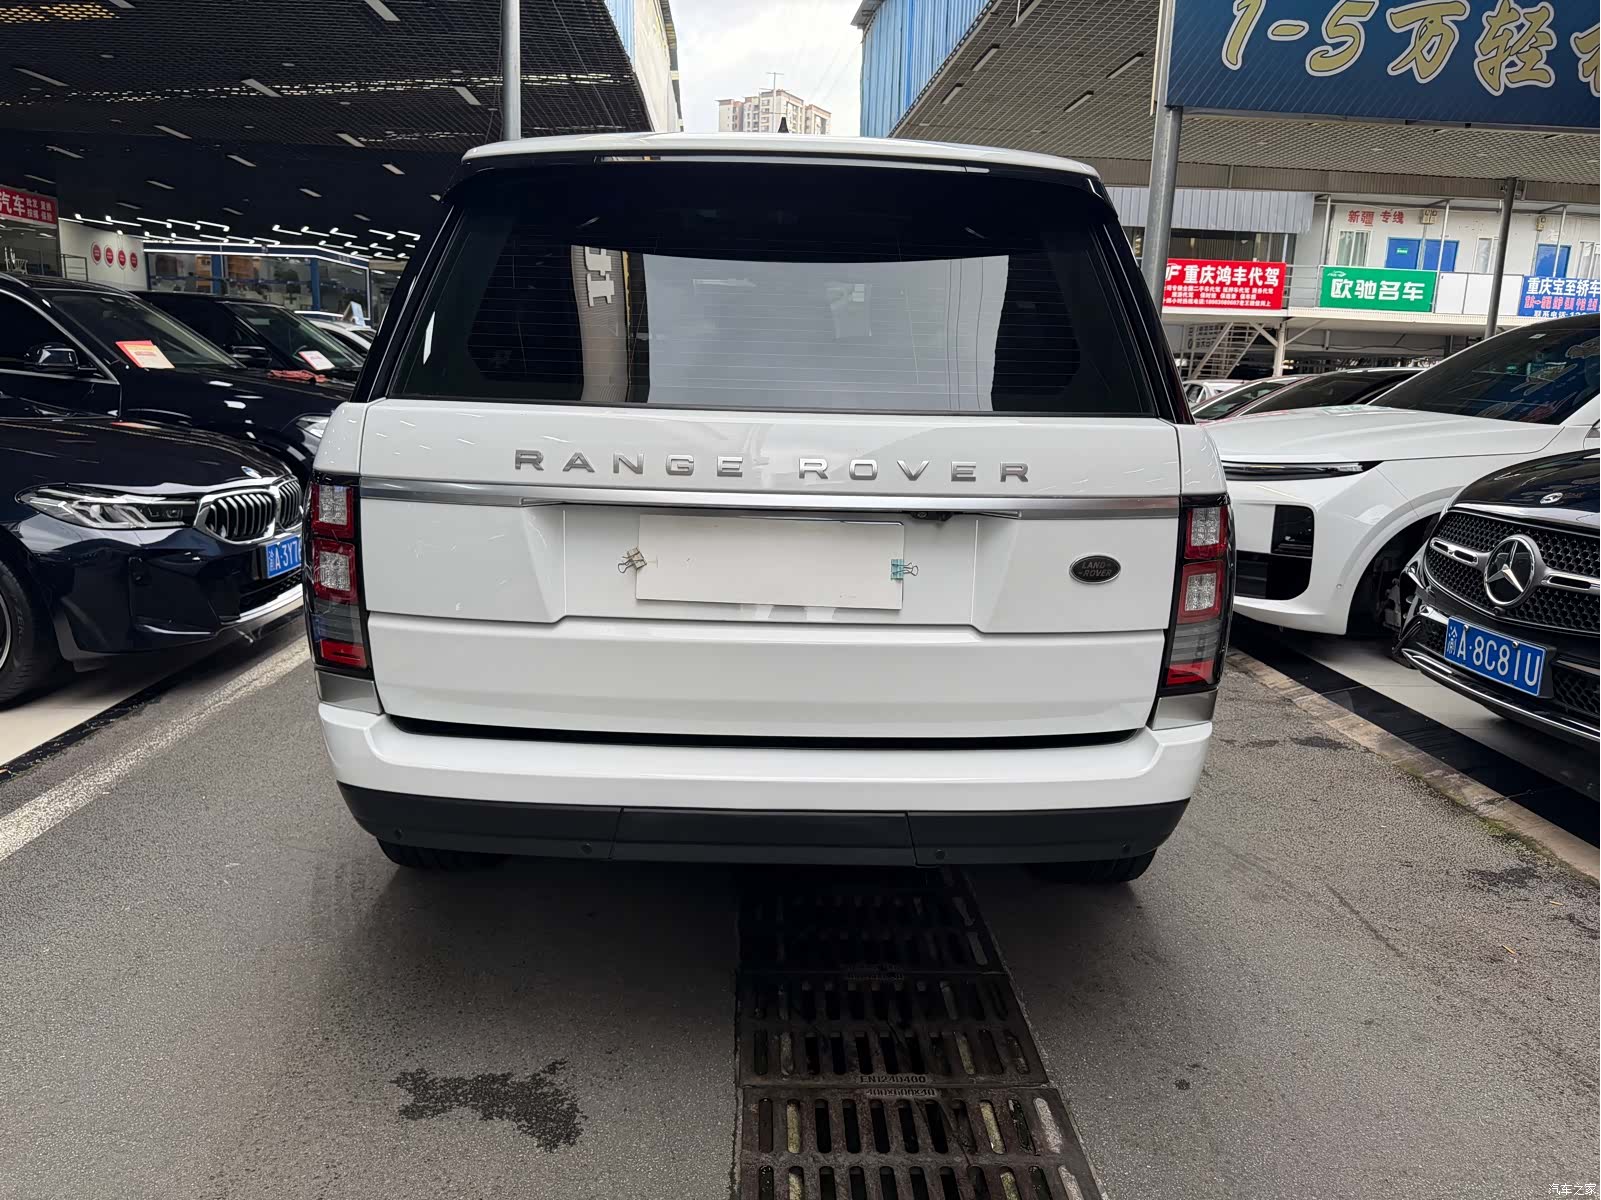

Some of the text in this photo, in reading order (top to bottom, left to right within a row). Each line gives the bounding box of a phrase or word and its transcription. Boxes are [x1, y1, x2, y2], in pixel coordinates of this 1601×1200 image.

[0, 191, 26, 217] 汽车
[1348, 210, 1404, 226] 新疆 专线
[1183, 264, 1280, 287] 重庆鸿丰代驾
[1330, 278, 1425, 301] 欧驰名车
[1526, 277, 1600, 297] 重庆宝至轿车
[515, 449, 1029, 483] RANGE ROVER
[1081, 561, 1106, 569] LAND
[1082, 569, 1112, 577] ROVER
